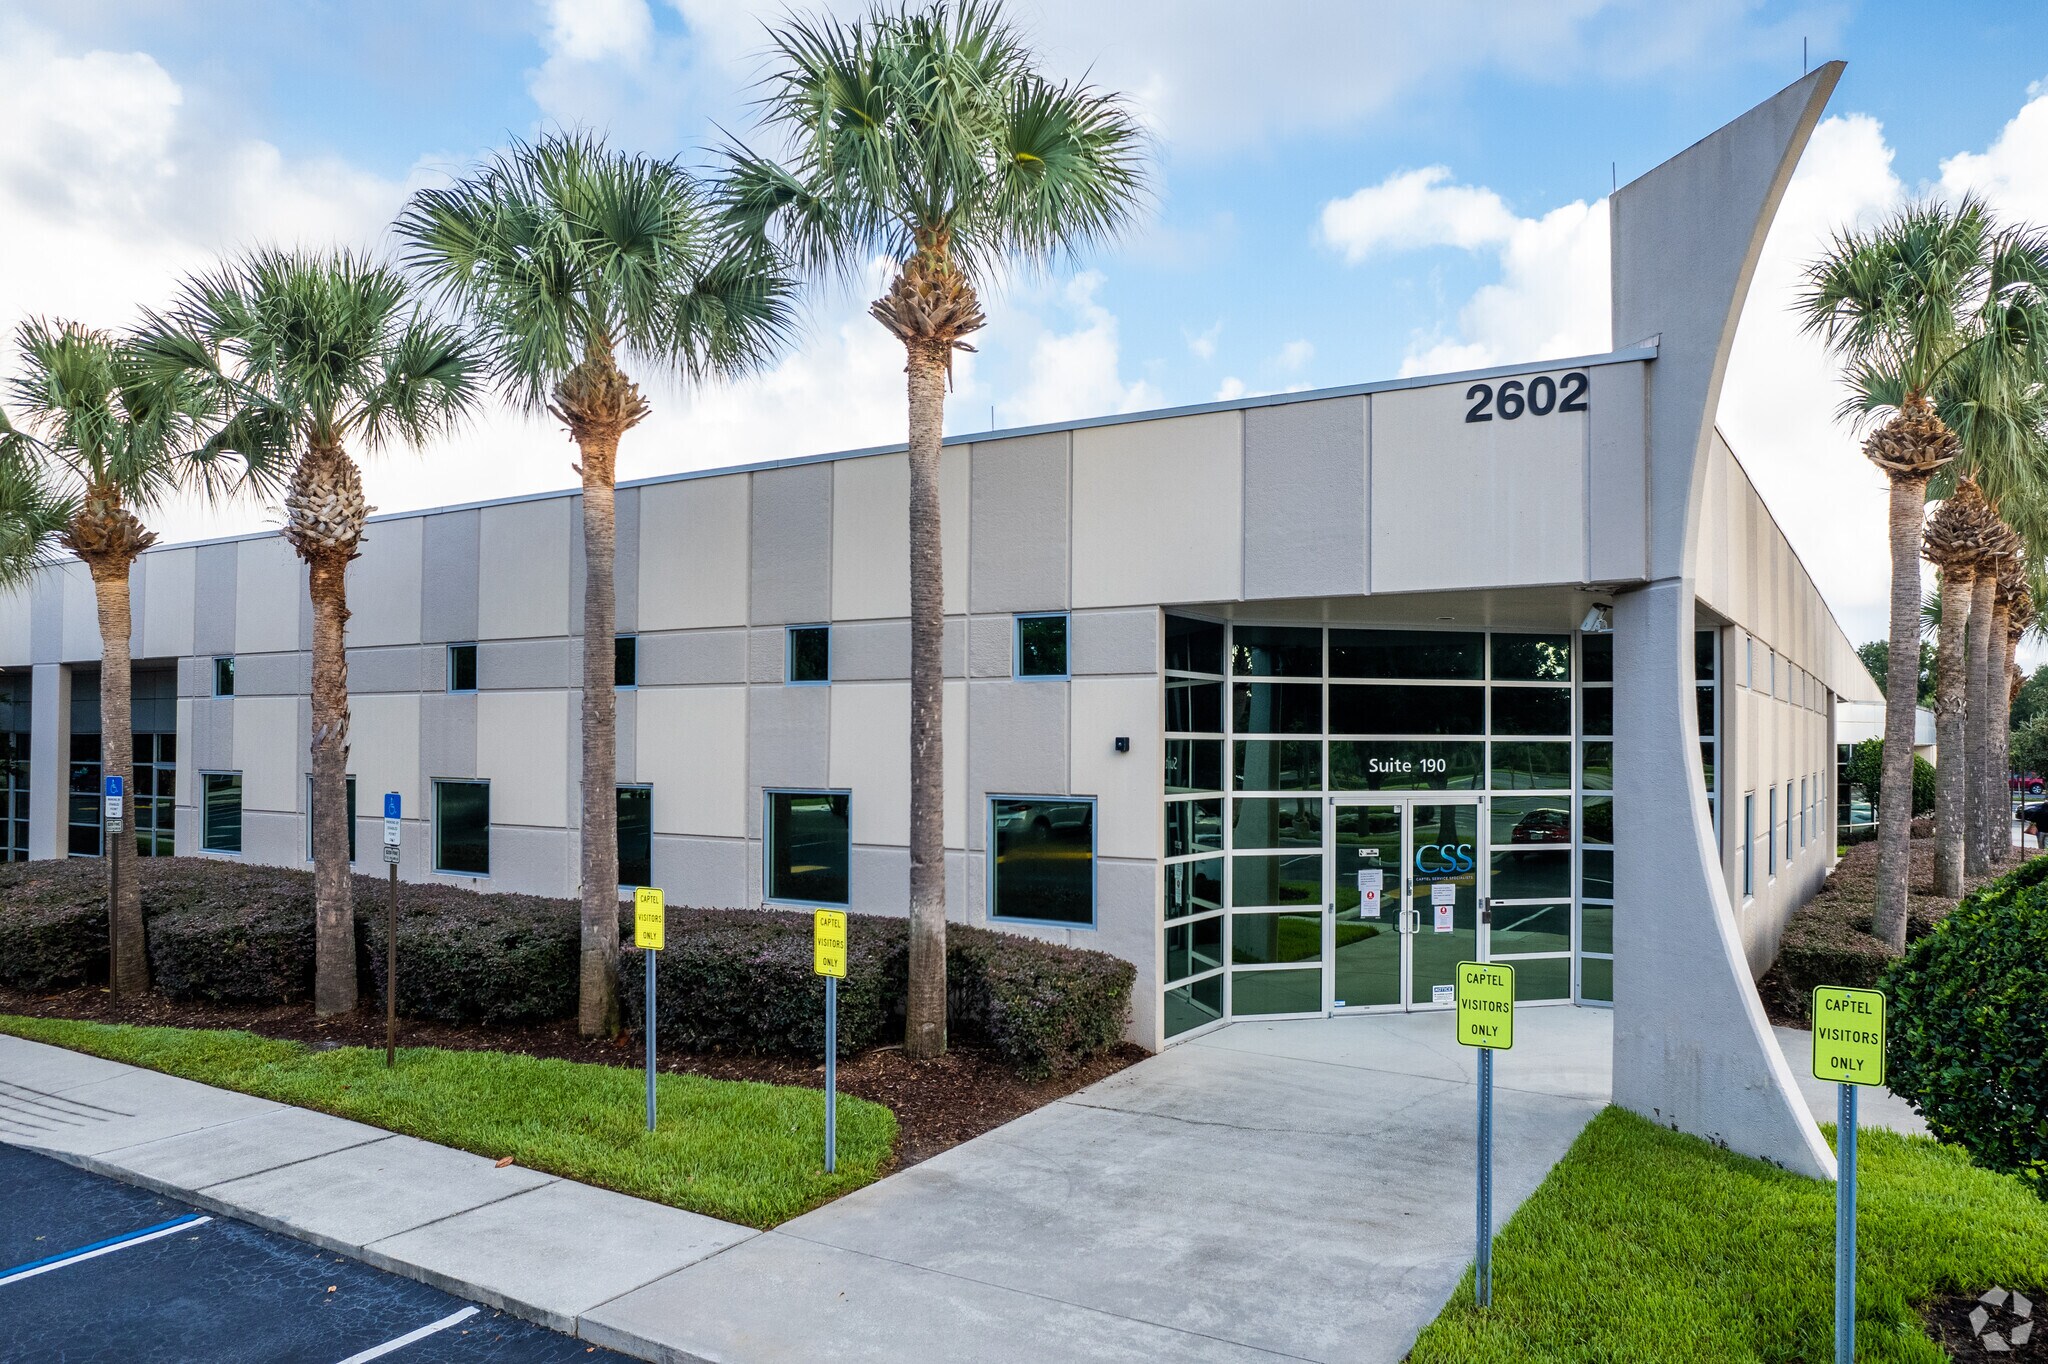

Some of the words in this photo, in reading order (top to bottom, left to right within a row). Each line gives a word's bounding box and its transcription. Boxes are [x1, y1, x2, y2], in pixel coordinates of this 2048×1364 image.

[1465, 372, 1588, 423] 2602
[1369, 757, 1412, 773] Suite
[1420, 758, 1446, 773] 190
[1416, 843, 1473, 873] CSS
[640, 894, 659, 904] CAPTEL
[638, 913, 662, 923] VISITORS
[820, 917, 841, 928] CAPTEL
[643, 931, 657, 940] ONLY
[818, 937, 844, 949] VISITORS
[822, 957, 838, 967] ONLY
[1466, 972, 1504, 987] CAPTEL
[1461, 998, 1509, 1013] VISITORS
[1825, 998, 1872, 1015] CAPTEL
[1471, 1024, 1498, 1037] ONLY
[1819, 1026, 1879, 1045] VISITORS
[1831, 1056, 1864, 1071] ONLY
